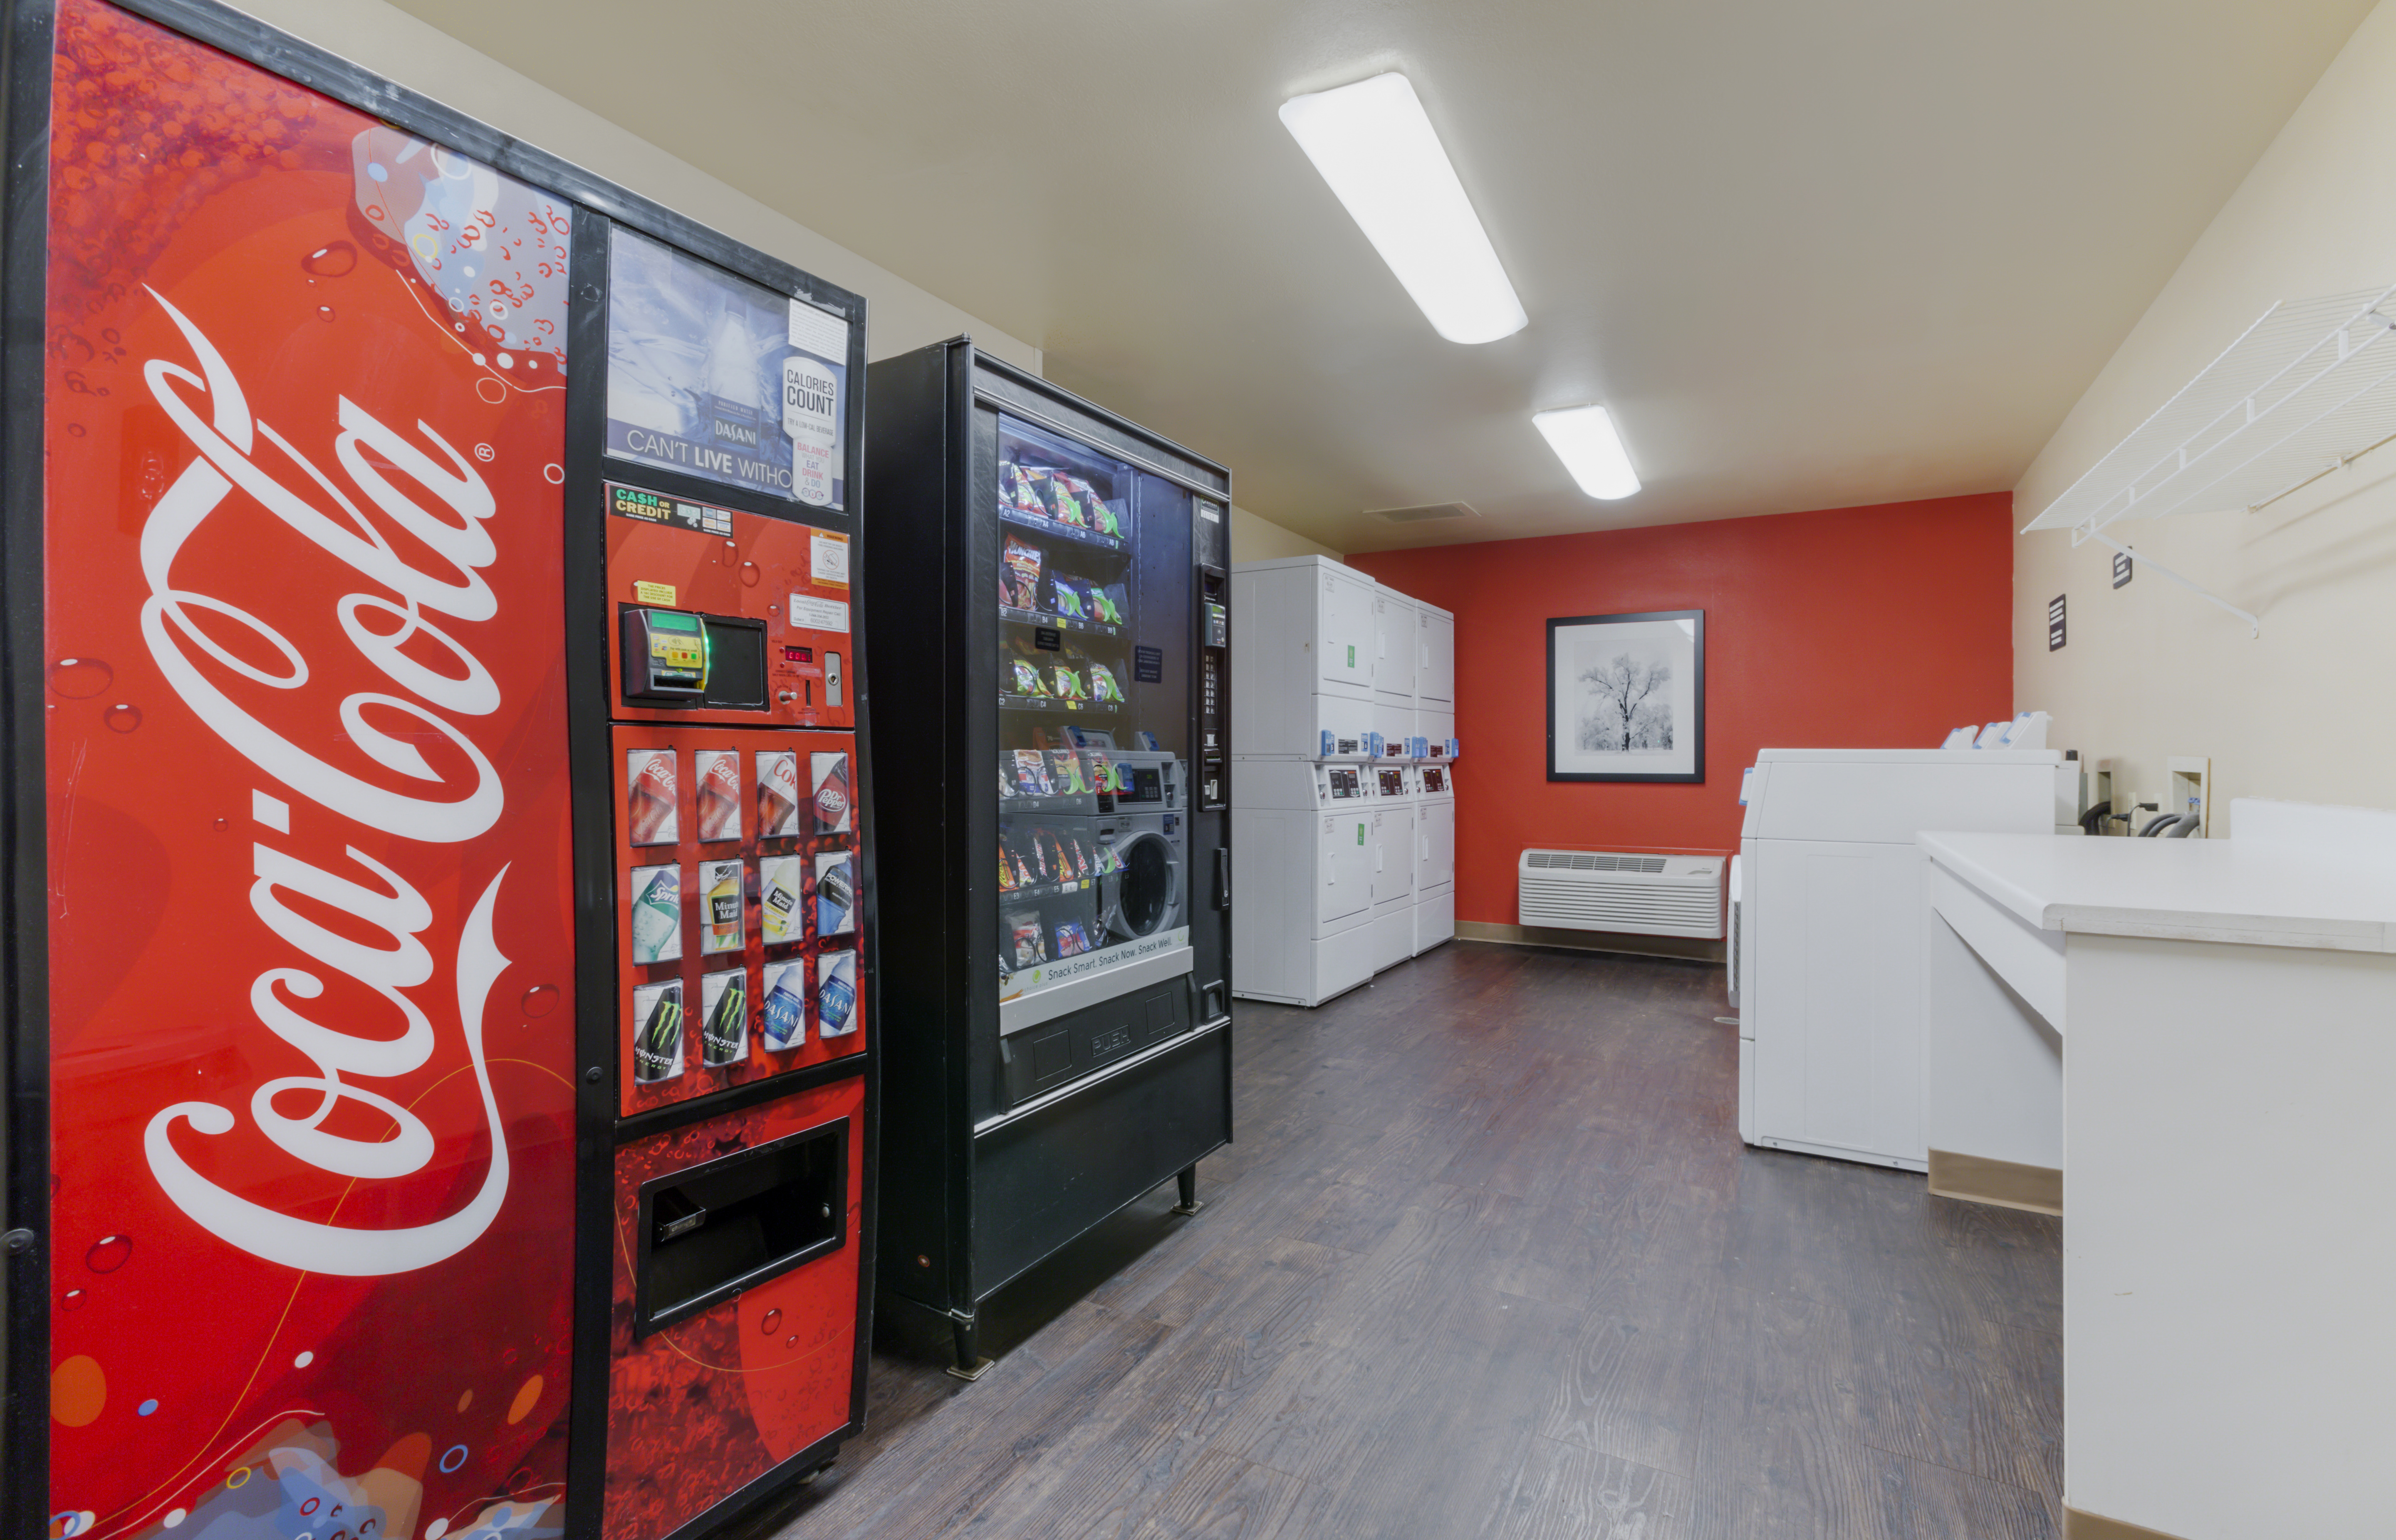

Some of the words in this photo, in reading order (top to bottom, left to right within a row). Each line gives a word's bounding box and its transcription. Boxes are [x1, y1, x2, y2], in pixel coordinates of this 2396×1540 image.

[787, 369, 834, 396] CALORIES
[787, 386, 834, 416] COUNT
[715, 420, 756, 445] DASANI
[799, 420, 816, 432] LOW-CAL
[817, 426, 833, 436] BEVERAGE
[797, 442, 829, 458] BALANCE
[802, 452, 814, 460] WHAT
[816, 455, 824, 464] YOU
[627, 429, 688, 462] CAN'T
[695, 446, 733, 474] LIVE
[738, 457, 792, 488] WITHO
[807, 460, 819, 470] EAT
[802, 467, 823, 480] DRINK
[805, 477, 809, 486] &
[811, 479, 820, 488] DO
[616, 500, 671, 519] CREDIT
[1003, 509, 1010, 517] A2
[1042, 520, 1049, 528] A4
[1008, 540, 1041, 564] MUNCHIES
[773, 759, 797, 792] Cok
[818, 789, 846, 808] Pepper
[829, 790, 842, 801] Dr
[715, 901, 739, 911] Minut
[772, 897, 789, 910] Maid
[773, 890, 793, 906] Minute
[720, 908, 738, 919] Maid
[1048, 965, 1071, 981] Snack
[1074, 959, 1097, 974] Smart.
[1099, 952, 1119, 967] Snack
[1121, 948, 1137, 961] Now.
[1139, 942, 1156, 955] Snack
[1158, 937, 1172, 948] Well.
[1024, 984, 1038, 992] choice
[819, 989, 851, 1015] DASANI
[764, 1000, 798, 1027] DASANI
[703, 1031, 739, 1049] MONSTER
[704, 1041, 733, 1053] ENERGY
[1094, 1027, 1129, 1055] PUSH
[635, 1046, 673, 1065] MONSTER
[635, 1056, 667, 1070] ENERGY
[672, 1220, 693, 1232] change
